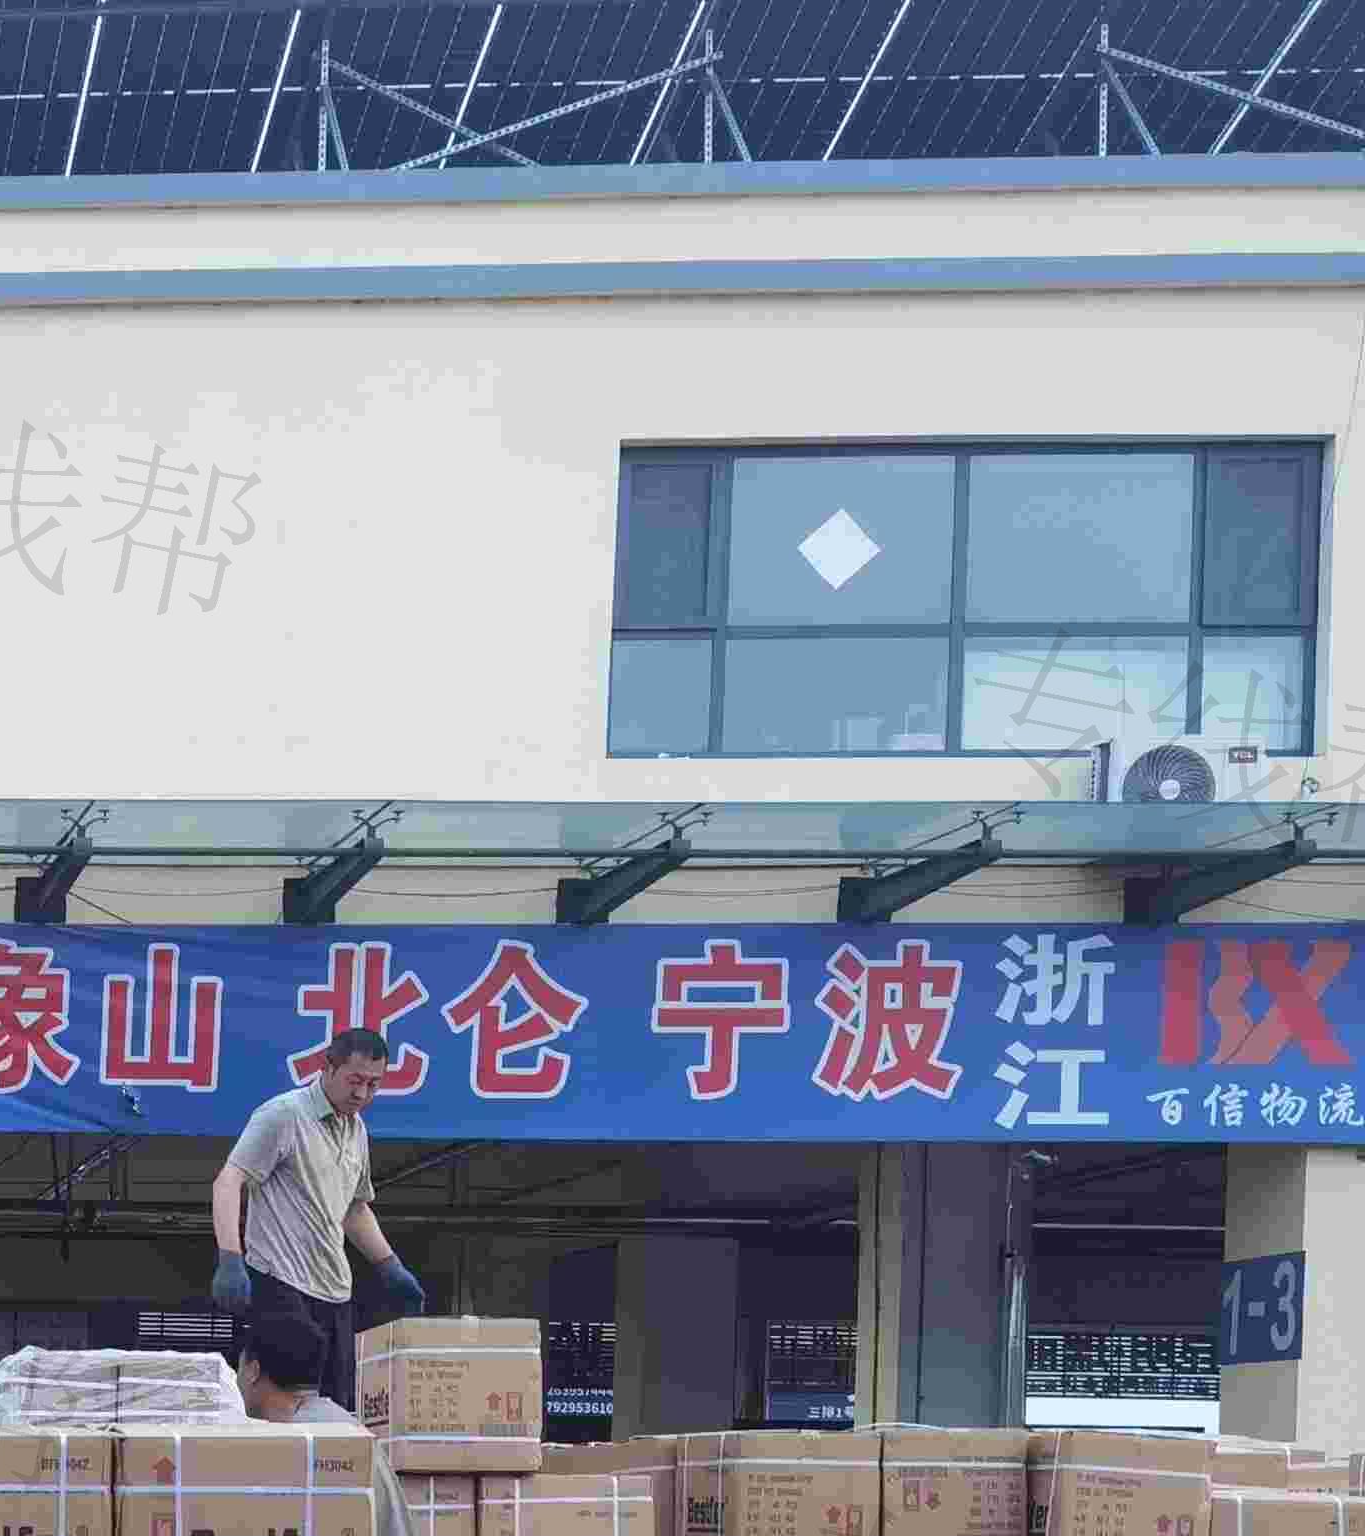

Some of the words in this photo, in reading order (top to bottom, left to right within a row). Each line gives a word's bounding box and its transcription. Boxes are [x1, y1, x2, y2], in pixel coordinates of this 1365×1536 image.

[287, 939, 589, 1100] 北仑
[651, 938, 964, 1101] 宁波
[993, 932, 1117, 1130] 浙江
[1145, 1082, 1365, 1127] 百信物流
[1224, 1256, 1297, 1356] 1-3
